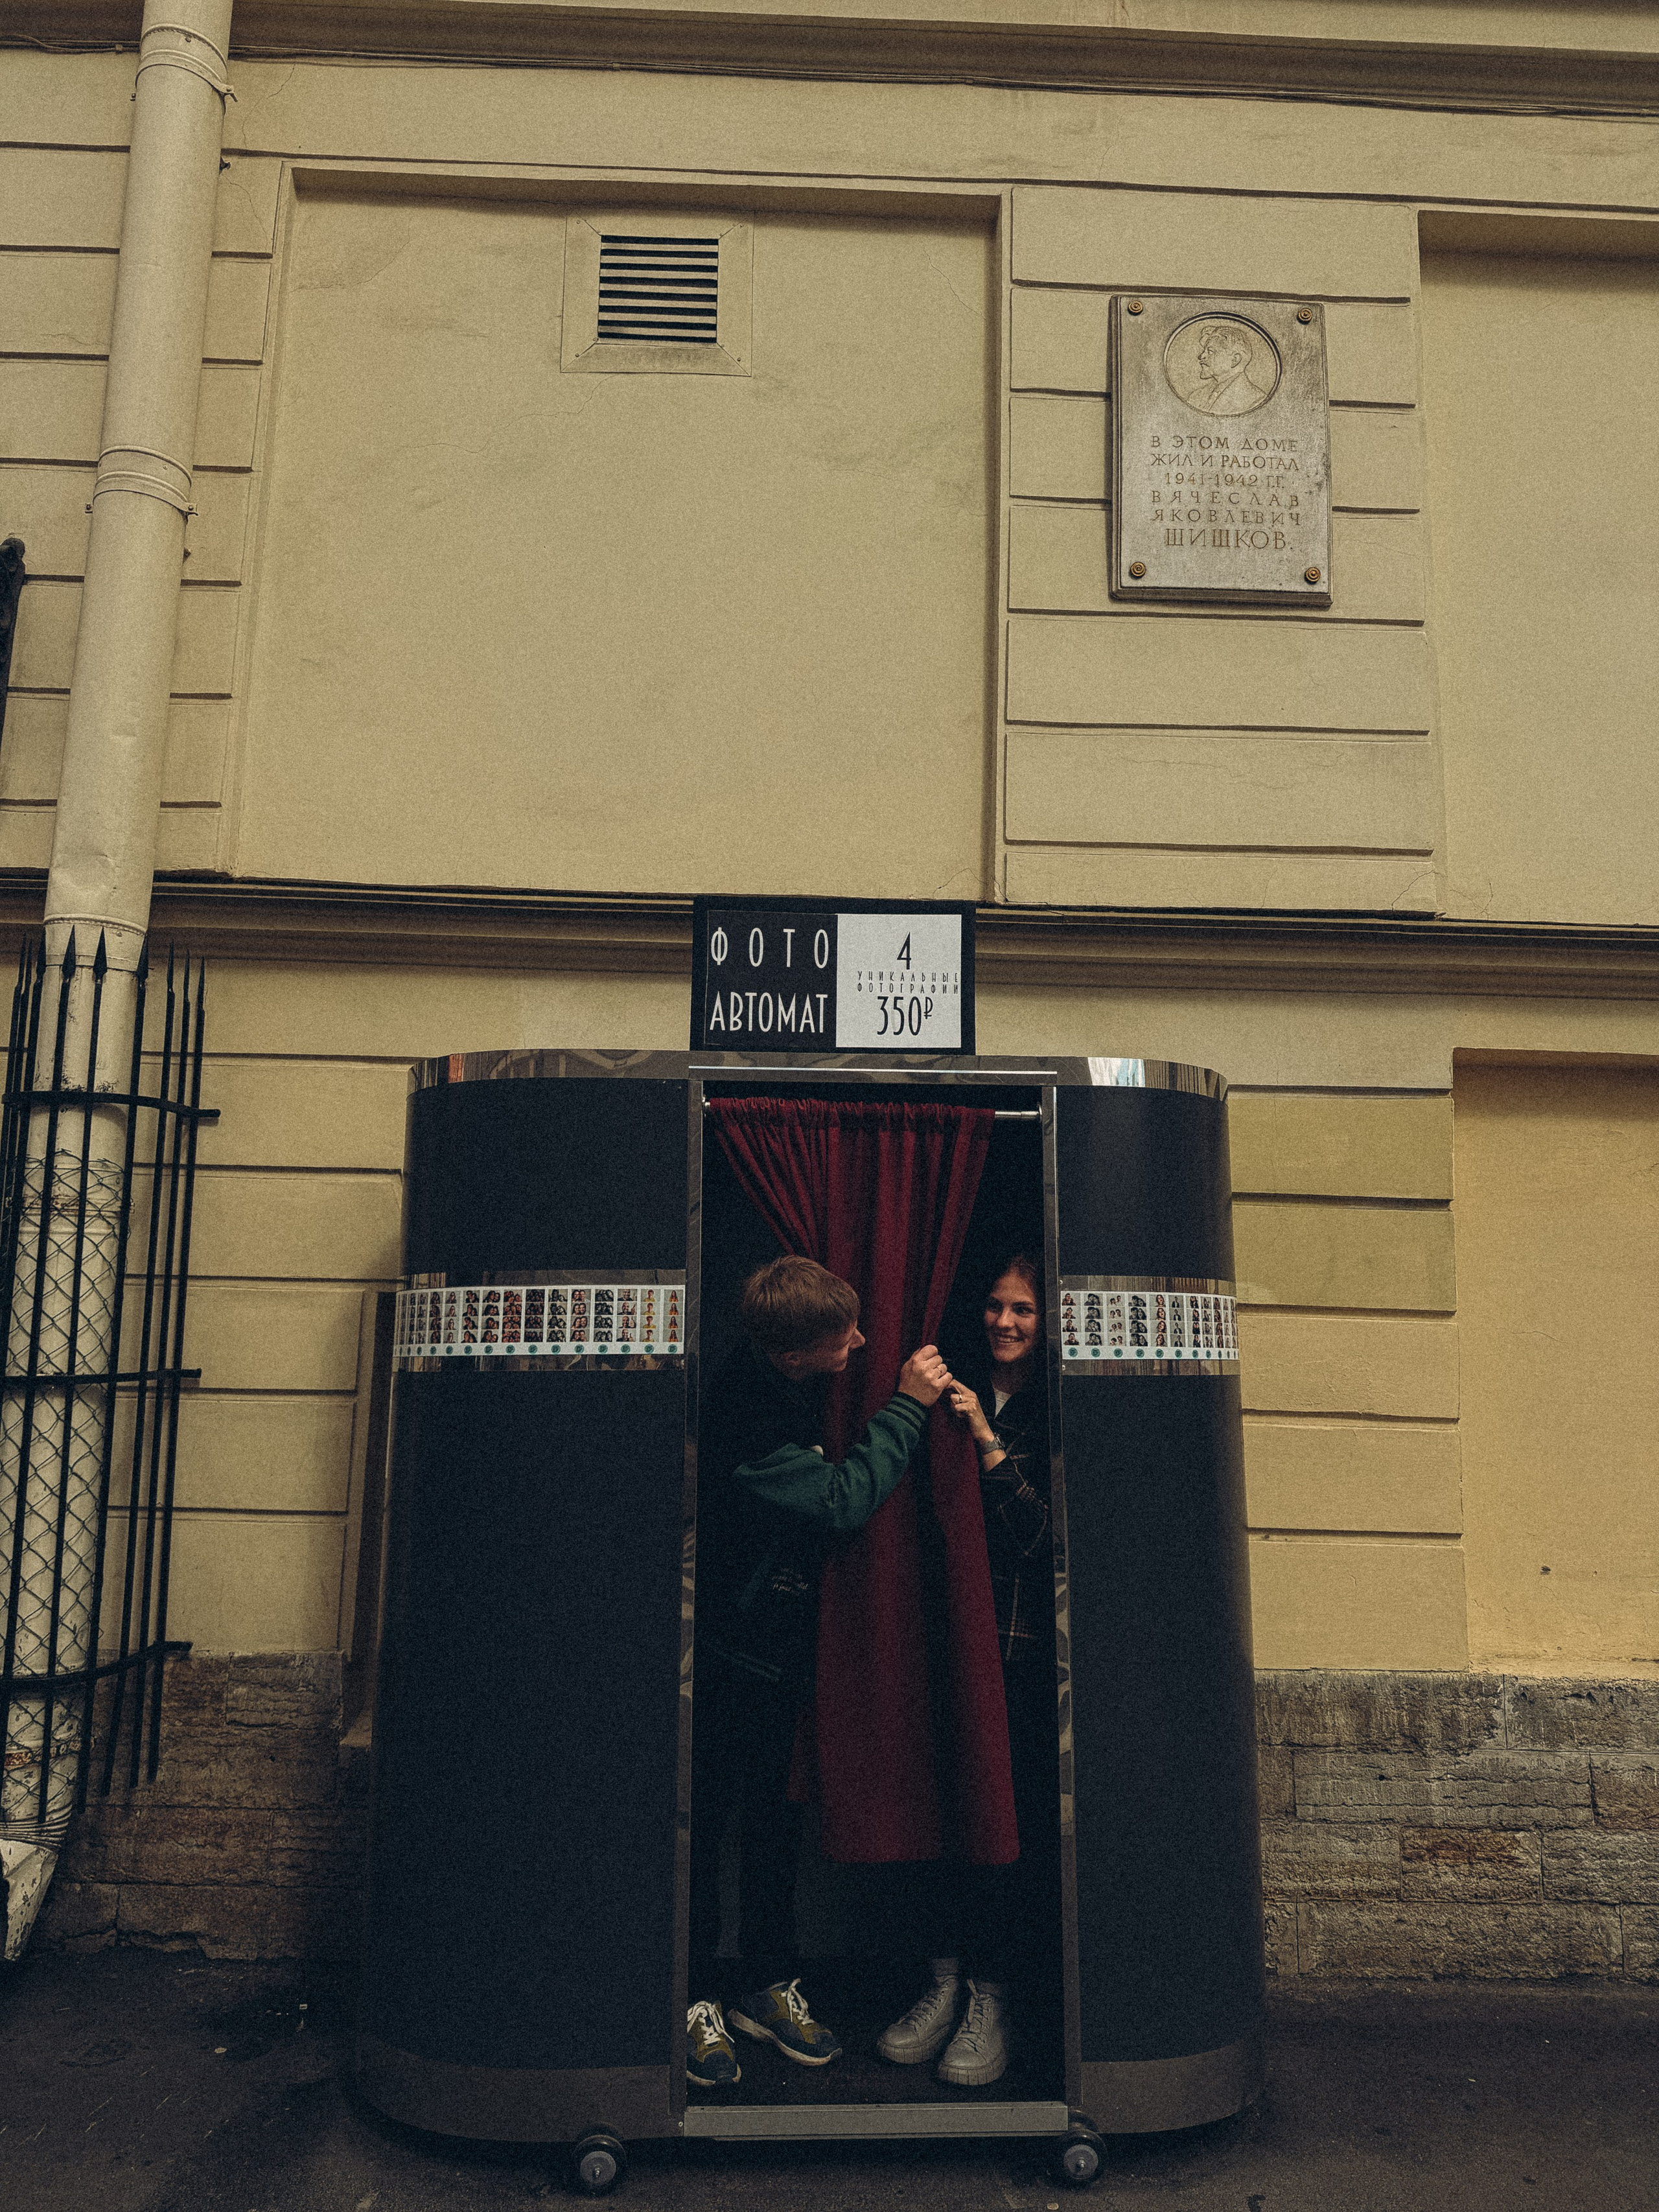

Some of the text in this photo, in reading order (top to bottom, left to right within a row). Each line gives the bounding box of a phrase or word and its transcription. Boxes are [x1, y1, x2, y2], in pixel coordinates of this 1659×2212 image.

[1151, 436, 1298, 452] В ЭТОМ ДОМЕ
[1151, 454, 1299, 471] ЖИЛ И РАБОТАЛ
[1166, 472, 1258, 487] 1941-1942
[1152, 490, 1299, 507] ВЯЧЕСЛАВ
[1152, 509, 1301, 526] ЯКОВЛЕВИЧ
[1166, 528, 1294, 550] ШИШКОВ.
[711, 927, 829, 969] ФОТО
[896, 931, 912, 970] 4
[857, 971, 958, 983] УНИКАЛЬНЫЕ
[857, 983, 958, 994] ФОТОГРАФИИ
[710, 990, 828, 1033] АВТОМАТ
